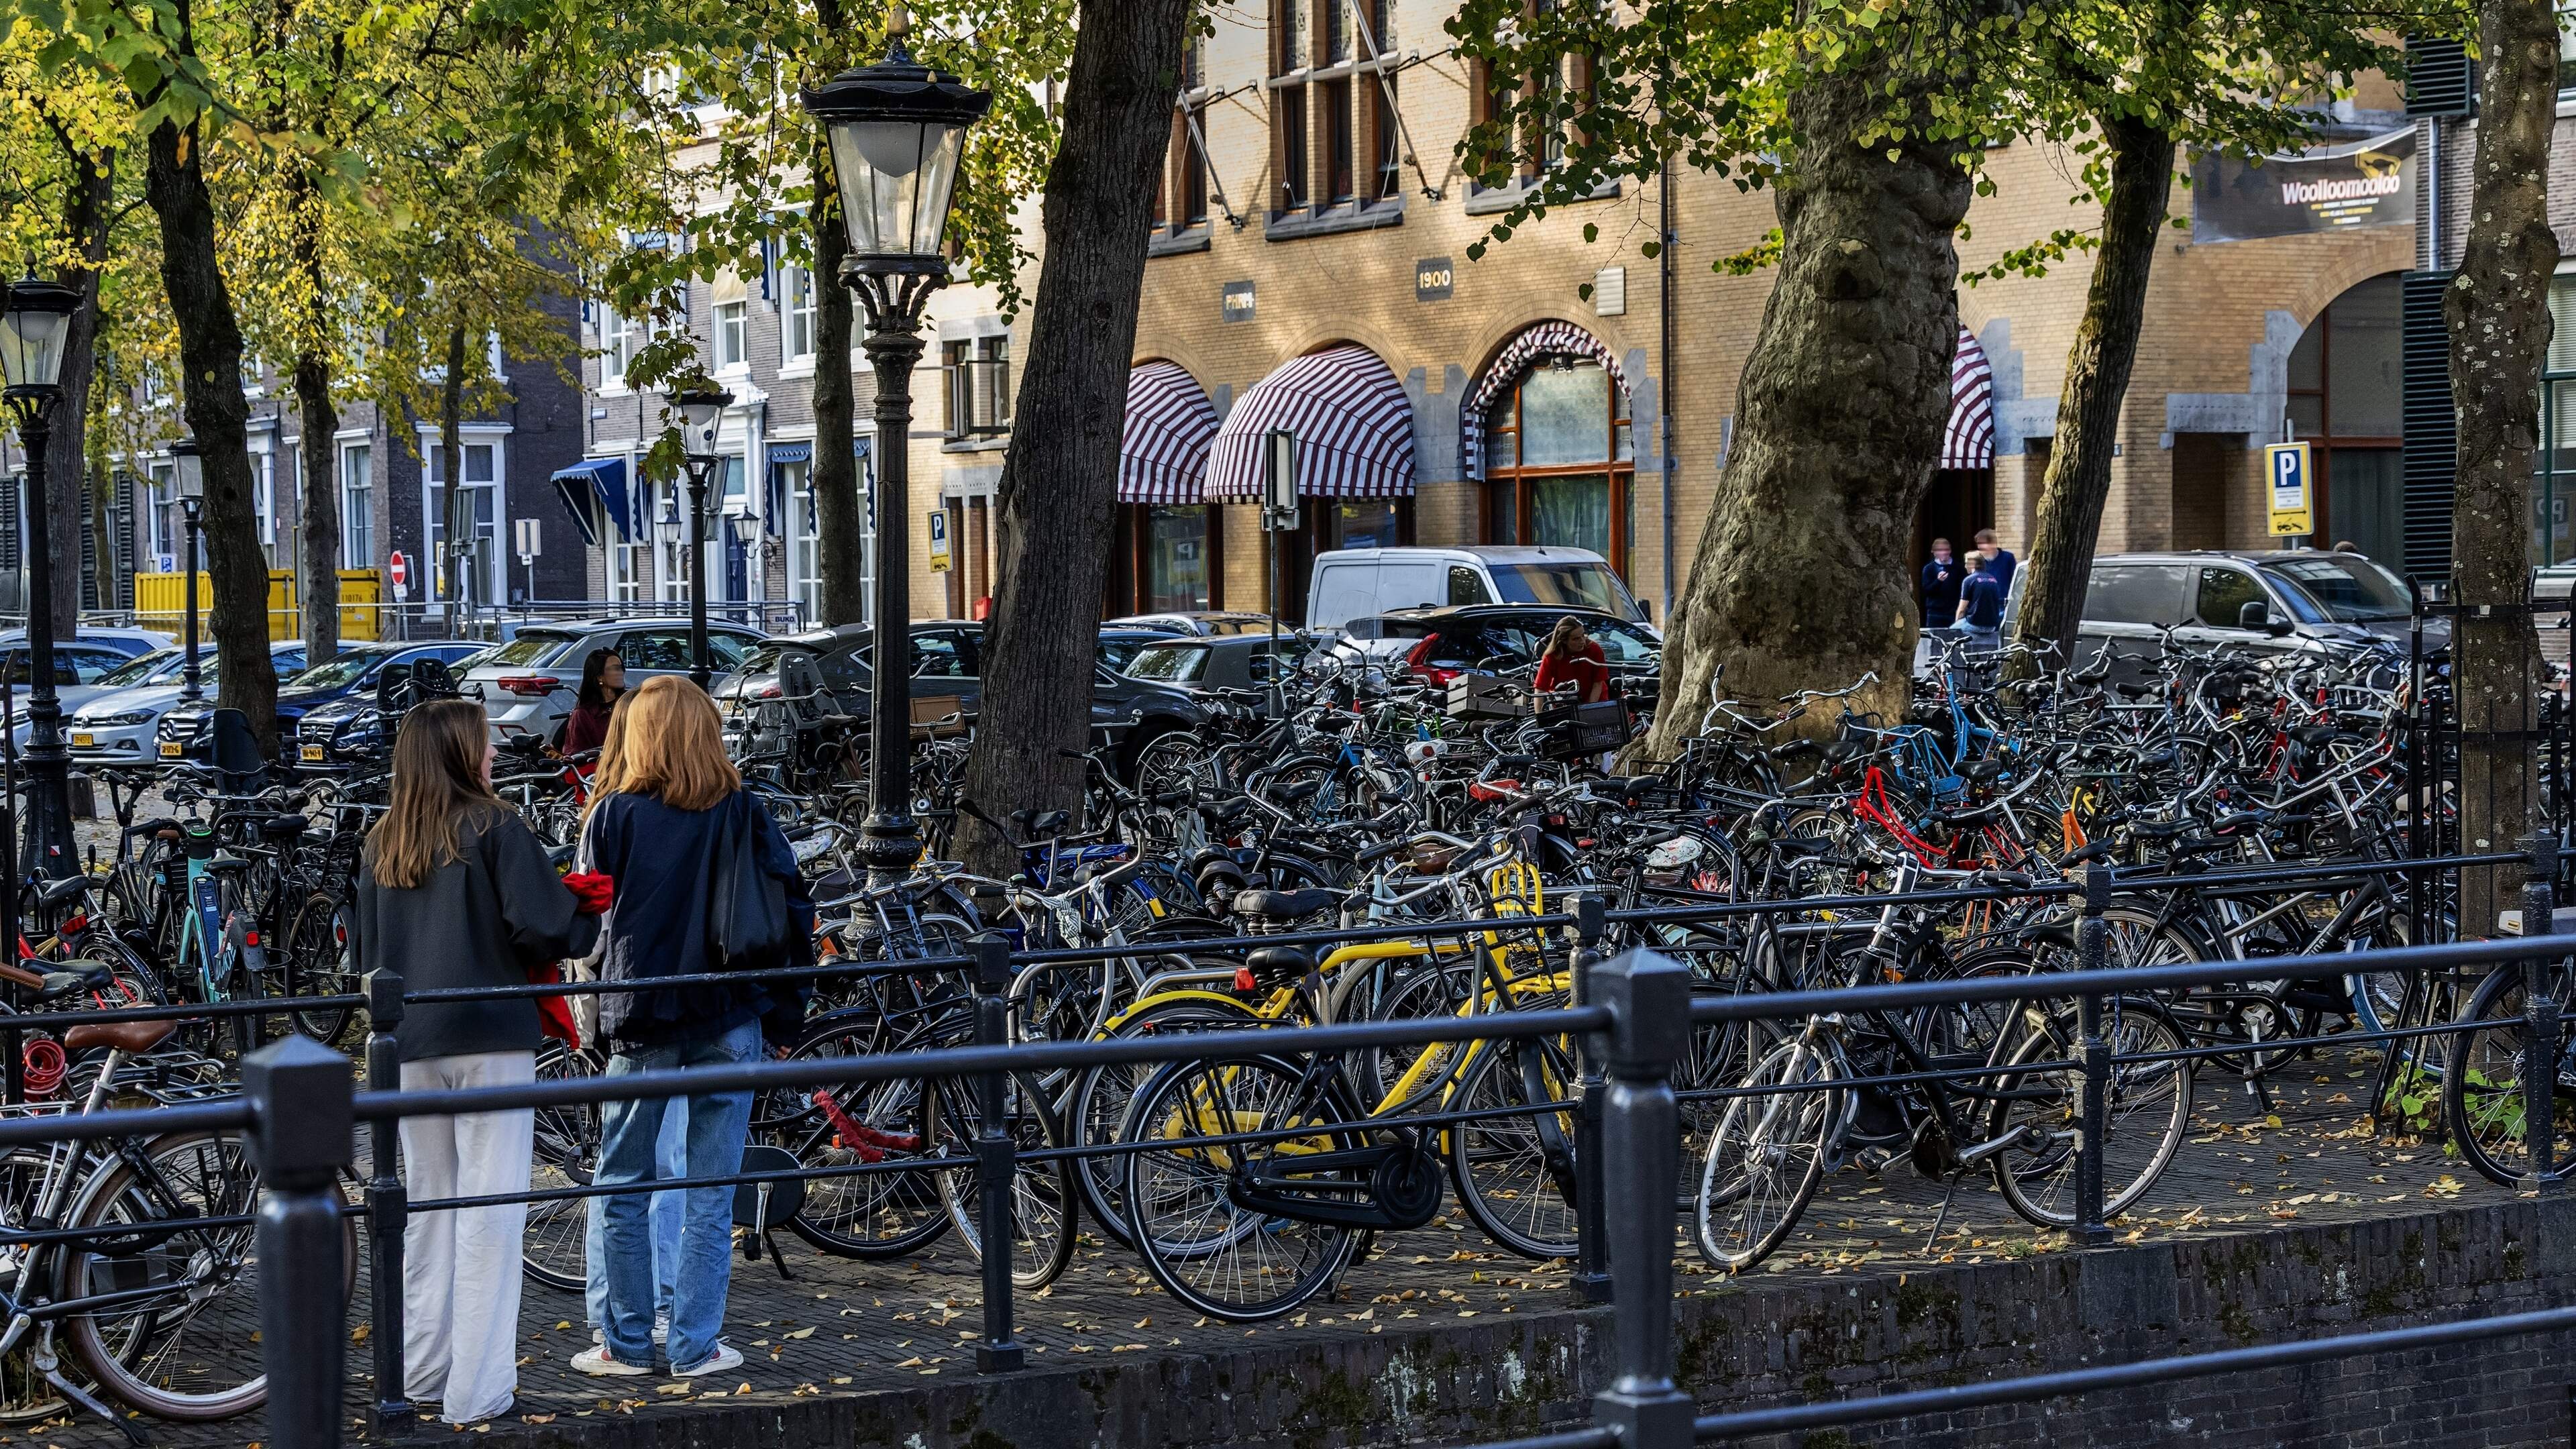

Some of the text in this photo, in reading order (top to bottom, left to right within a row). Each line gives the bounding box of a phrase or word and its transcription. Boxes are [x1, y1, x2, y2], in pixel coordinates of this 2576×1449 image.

[2282, 172, 2400, 205] Woolloomooloo
[1419, 270, 1451, 288] 1900
[2279, 452, 2296, 486] P
[933, 515, 942, 538] P
[1886, 1010, 1922, 1054] ATAVUS
